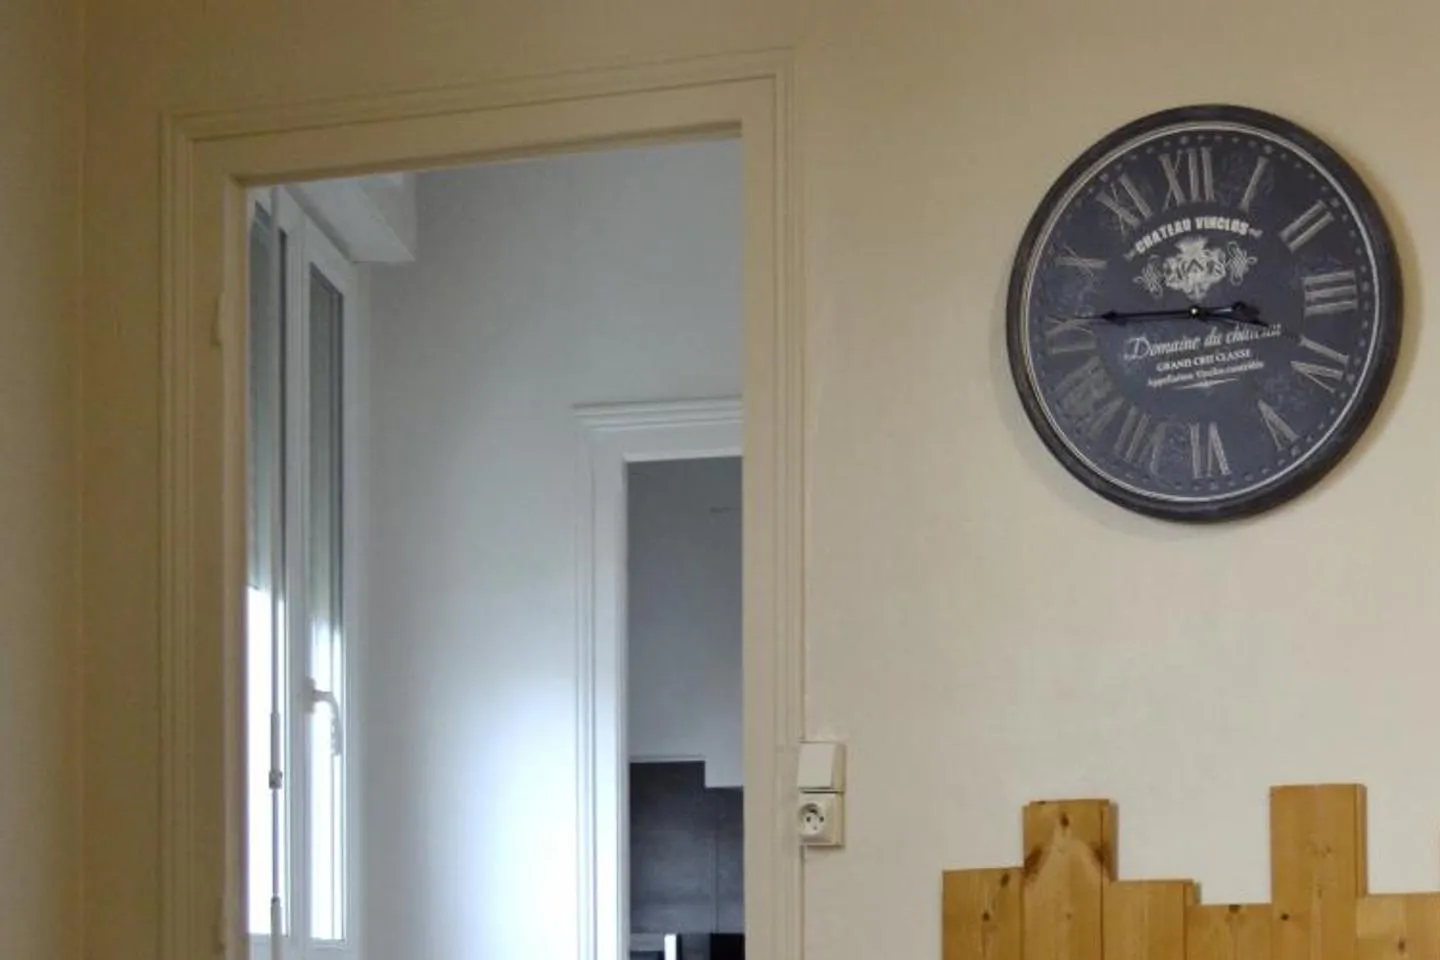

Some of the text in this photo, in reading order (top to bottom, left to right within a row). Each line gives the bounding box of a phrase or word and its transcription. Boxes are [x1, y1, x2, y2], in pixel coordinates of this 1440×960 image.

[1096, 174, 1153, 235] XI
[1157, 146, 1217, 212] XII
[1237, 155, 1270, 212] I
[1278, 199, 1335, 252] II
[1303, 270, 1359, 318] III
[1123, 335, 1200, 360] Domaine
[1204, 326, 1222, 347] du
[1156, 358, 1192, 372] GRAND
[1188, 421, 1232, 479] VI
